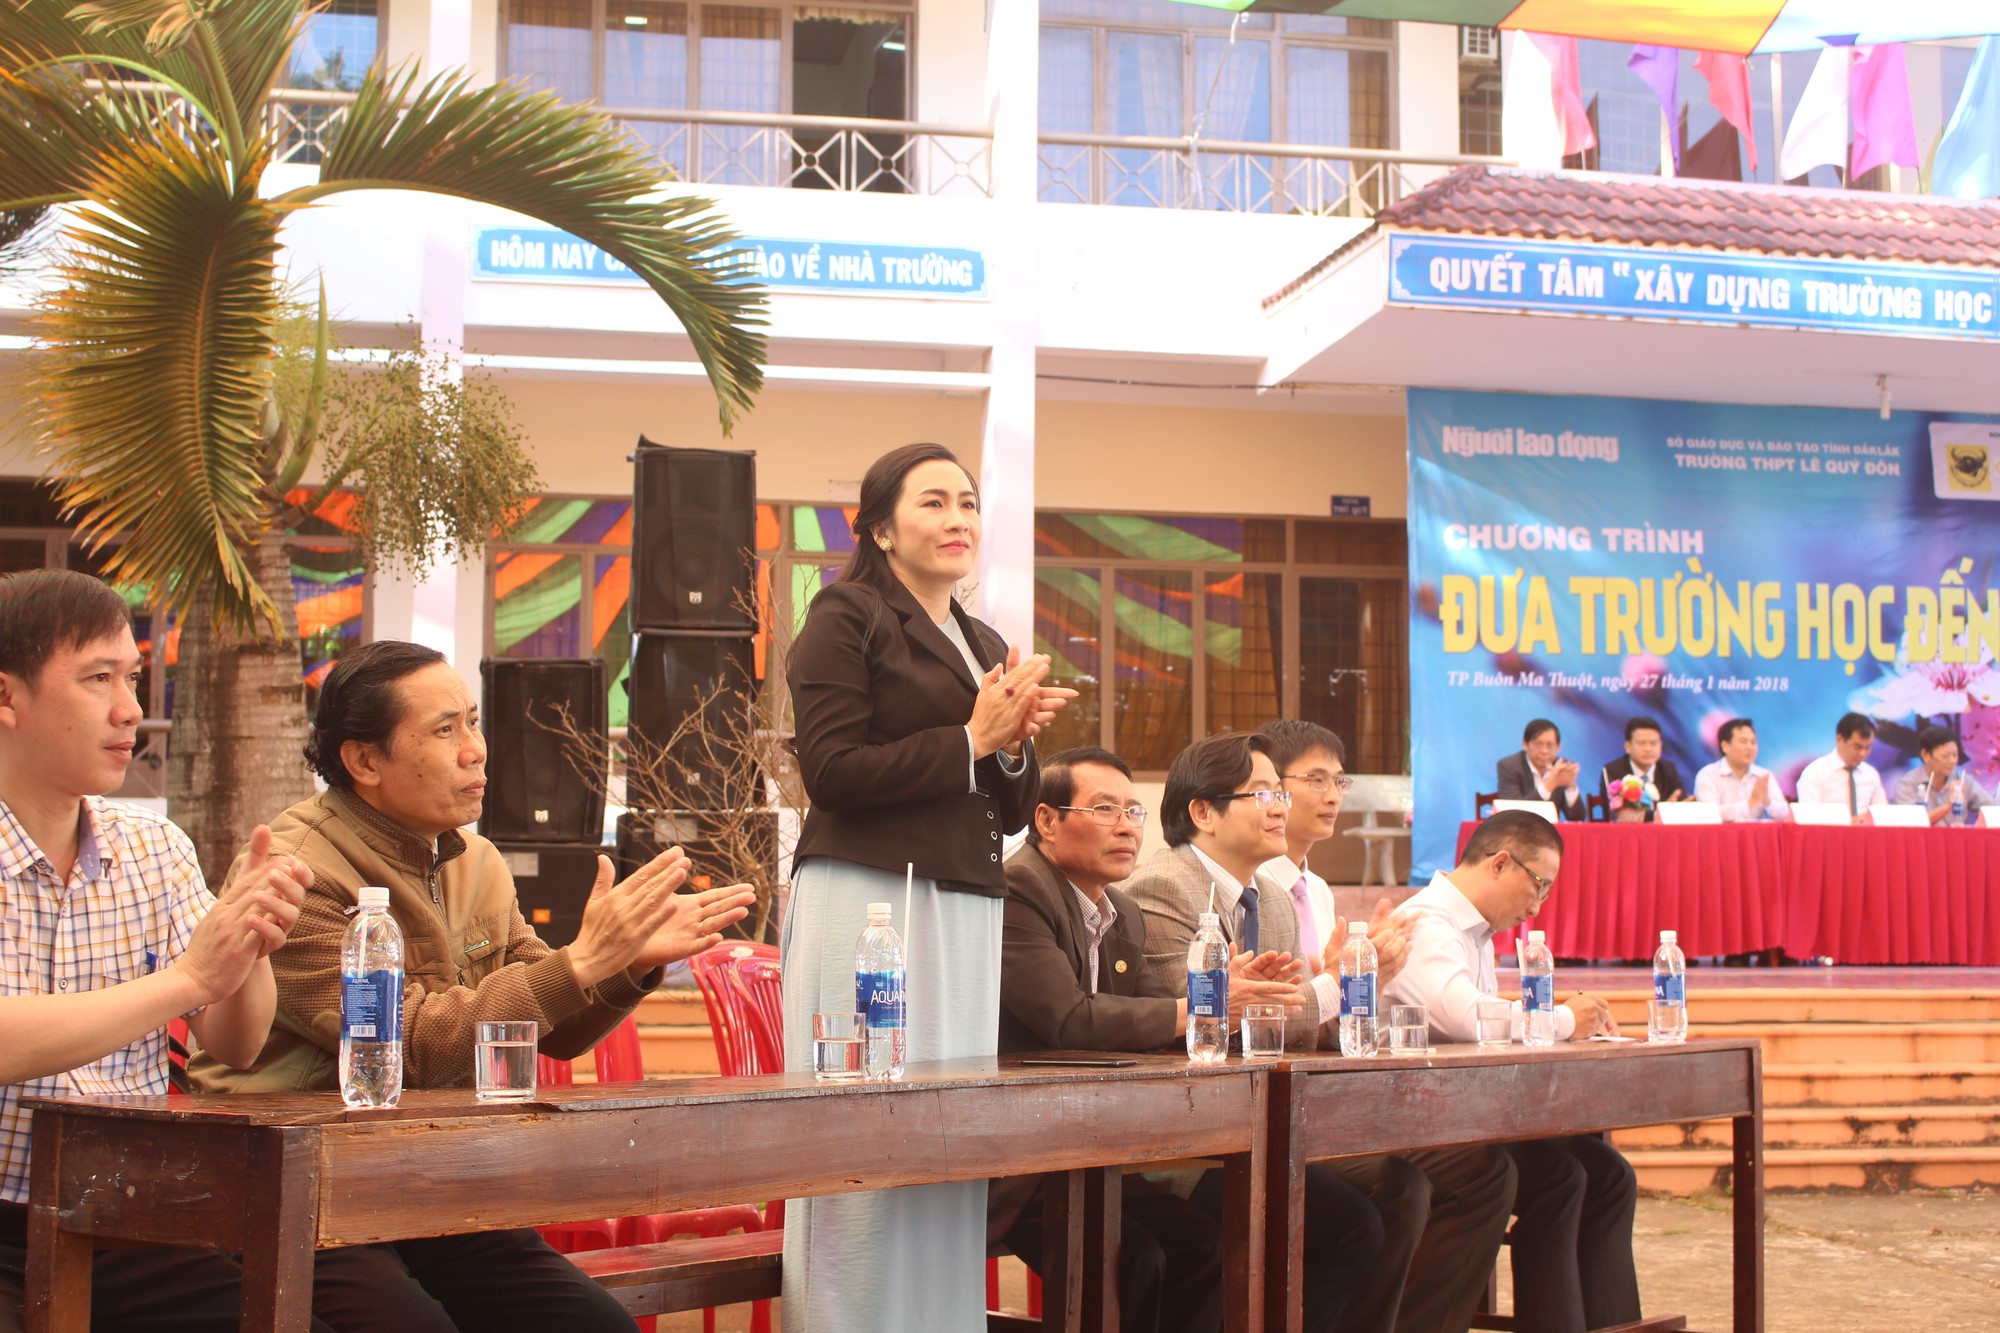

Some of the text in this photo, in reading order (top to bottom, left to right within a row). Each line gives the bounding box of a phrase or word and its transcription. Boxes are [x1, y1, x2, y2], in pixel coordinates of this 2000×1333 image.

[491, 234, 545, 269] HÔM
[551, 242, 600, 271] NAY
[791, 243, 821, 281] VỀ
[829, 249, 876, 283] NHÀ
[881, 252, 974, 287] TRƯỜNG
[1429, 251, 1526, 294] QUYẾT
[1537, 257, 1605, 298] TÂM
[1706, 273, 1791, 314] DỰNG
[1802, 276, 1923, 320] TRƯỜNG
[1934, 288, 1993, 329] HỌC
[1516, 427, 1555, 457] lao
[1747, 438, 1765, 451] VÀ
[1674, 451, 1748, 471] TRƯỜNG
[1750, 455, 1796, 473] THPT
[1800, 456, 1821, 474] LÊ
[1863, 459, 1901, 477] ĐÔN
[1442, 521, 1705, 555] CHƯƠNG TRÌNH
[1438, 556, 2000, 677] ĐƯA TRƯỜNG HỌC ĐẾN
[1447, 671, 1470, 687] TP
[1472, 671, 1514, 687] Buôn
[1517, 671, 1544, 687] Ma
[1600, 674, 1636, 693] ngày
[1639, 674, 1659, 689] 27
[1661, 673, 1703, 693] tháng
[1706, 675, 1714, 689] 1
[1718, 675, 1751, 690] năm
[1753, 676, 1790, 692] 2018
